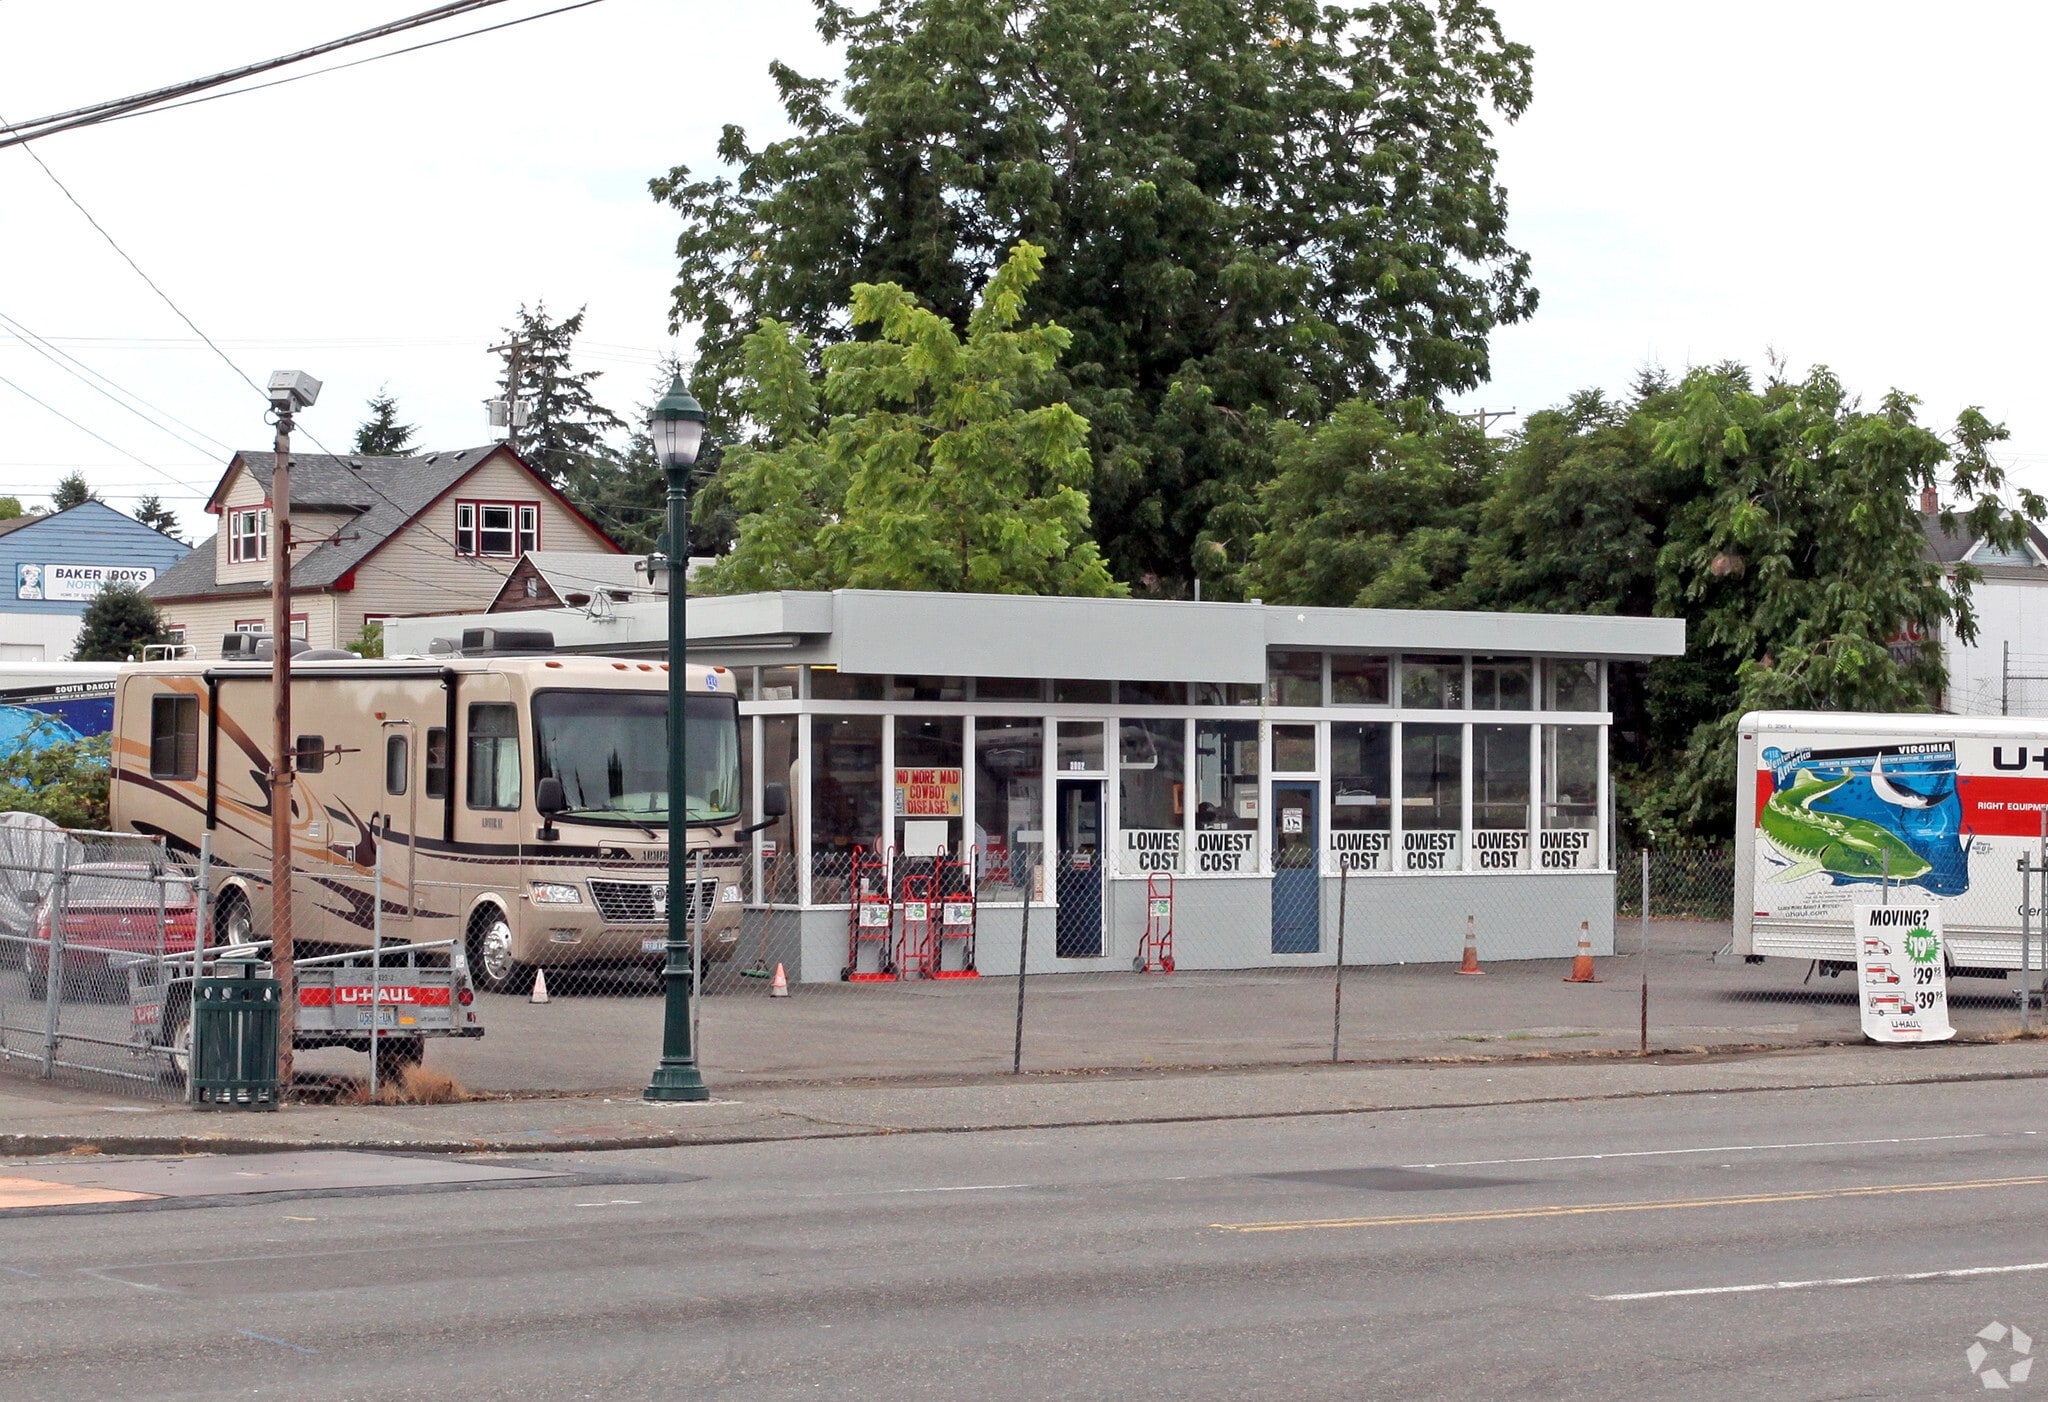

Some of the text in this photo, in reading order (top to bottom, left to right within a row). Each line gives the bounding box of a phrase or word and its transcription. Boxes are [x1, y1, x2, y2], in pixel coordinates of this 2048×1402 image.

[55, 568, 147, 581] BAKER BOYS
[55, 684, 83, 694] SOUTH
[1898, 743, 1951, 755] VIRGINIA
[896, 769, 959, 785] NO MORE MAD
[910, 785, 946, 799] COWBOY
[907, 800, 949, 814] DISEASE!
[1977, 801, 2005, 810] RIGHT
[1330, 832, 1391, 851] LOWEST
[1139, 851, 1179, 870] COST
[1200, 853, 1242, 872] COST
[1340, 852, 1380, 870] COST
[1407, 852, 1446, 870] COST
[1480, 851, 1519, 869] COST
[1542, 850, 1580, 868] COST
[1870, 909, 1930, 926] MOVING?
[341, 987, 415, 1002] U-HAUL
[1891, 1020, 1921, 1028] U-HAUL
